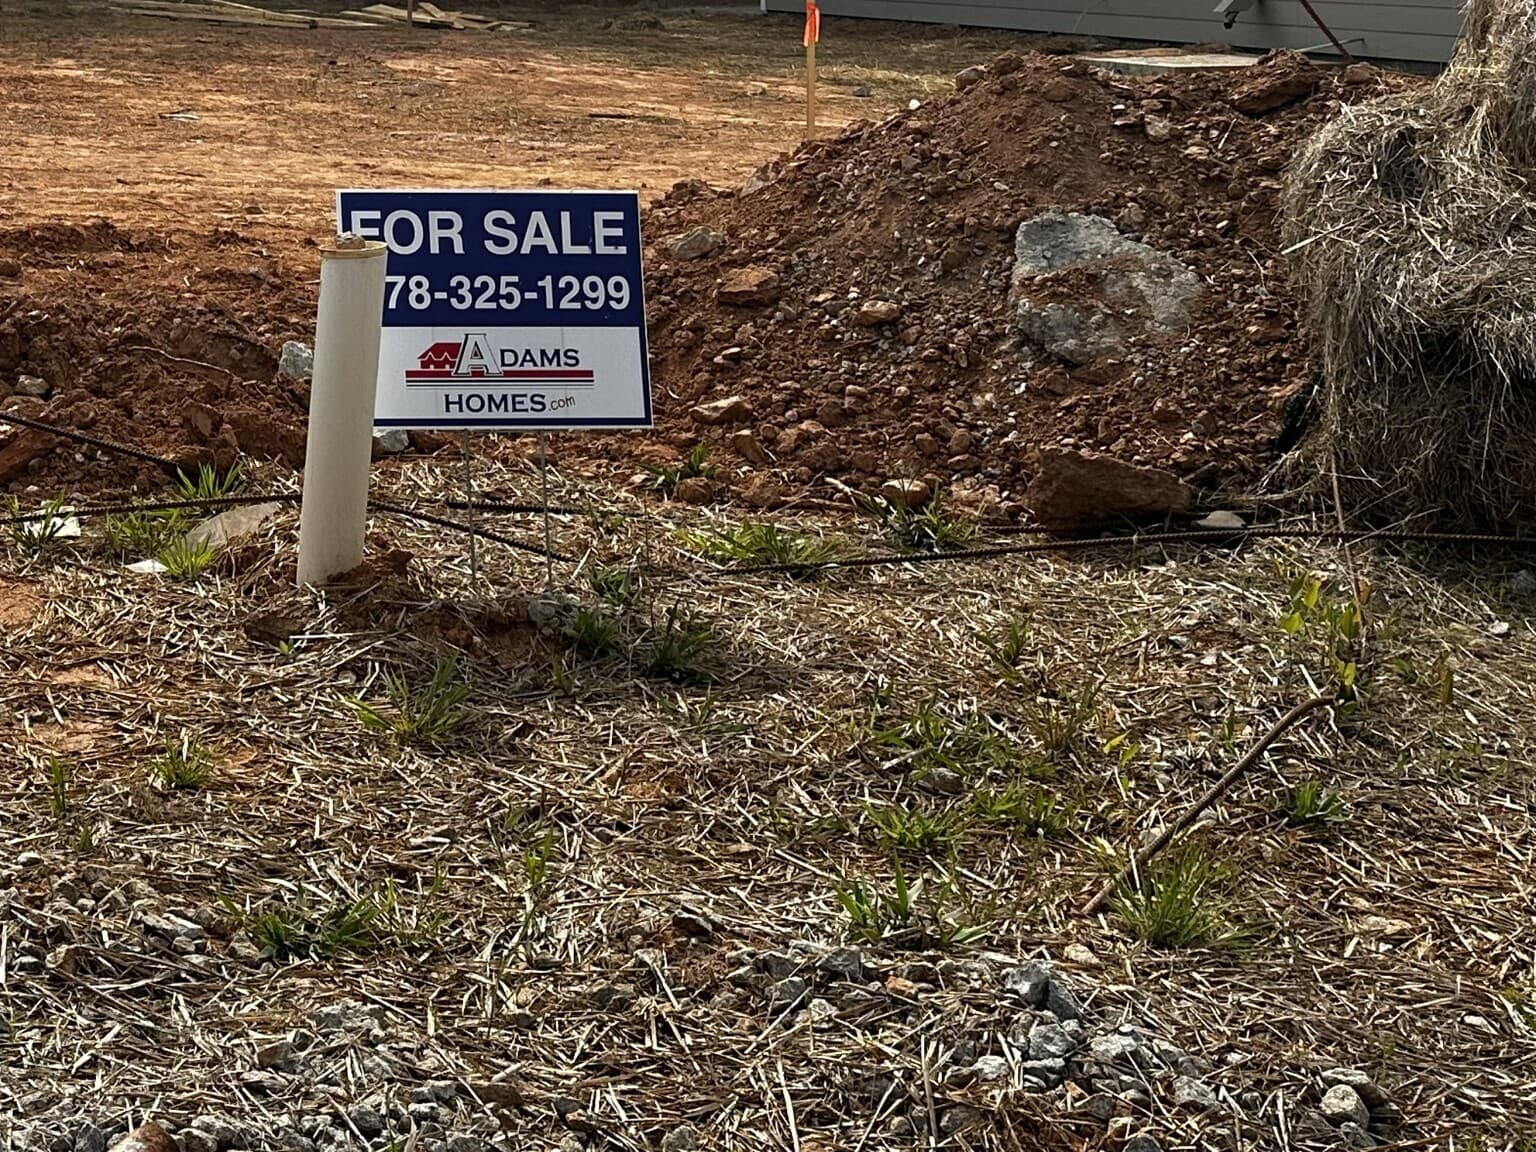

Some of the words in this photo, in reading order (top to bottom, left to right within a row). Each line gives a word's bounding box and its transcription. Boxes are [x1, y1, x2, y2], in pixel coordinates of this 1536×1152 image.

[350, 209, 465, 255] FOR
[483, 210, 628, 255] SALE
[384, 274, 631, 311] 78-325-1299
[451, 333, 580, 376] ADAMS
